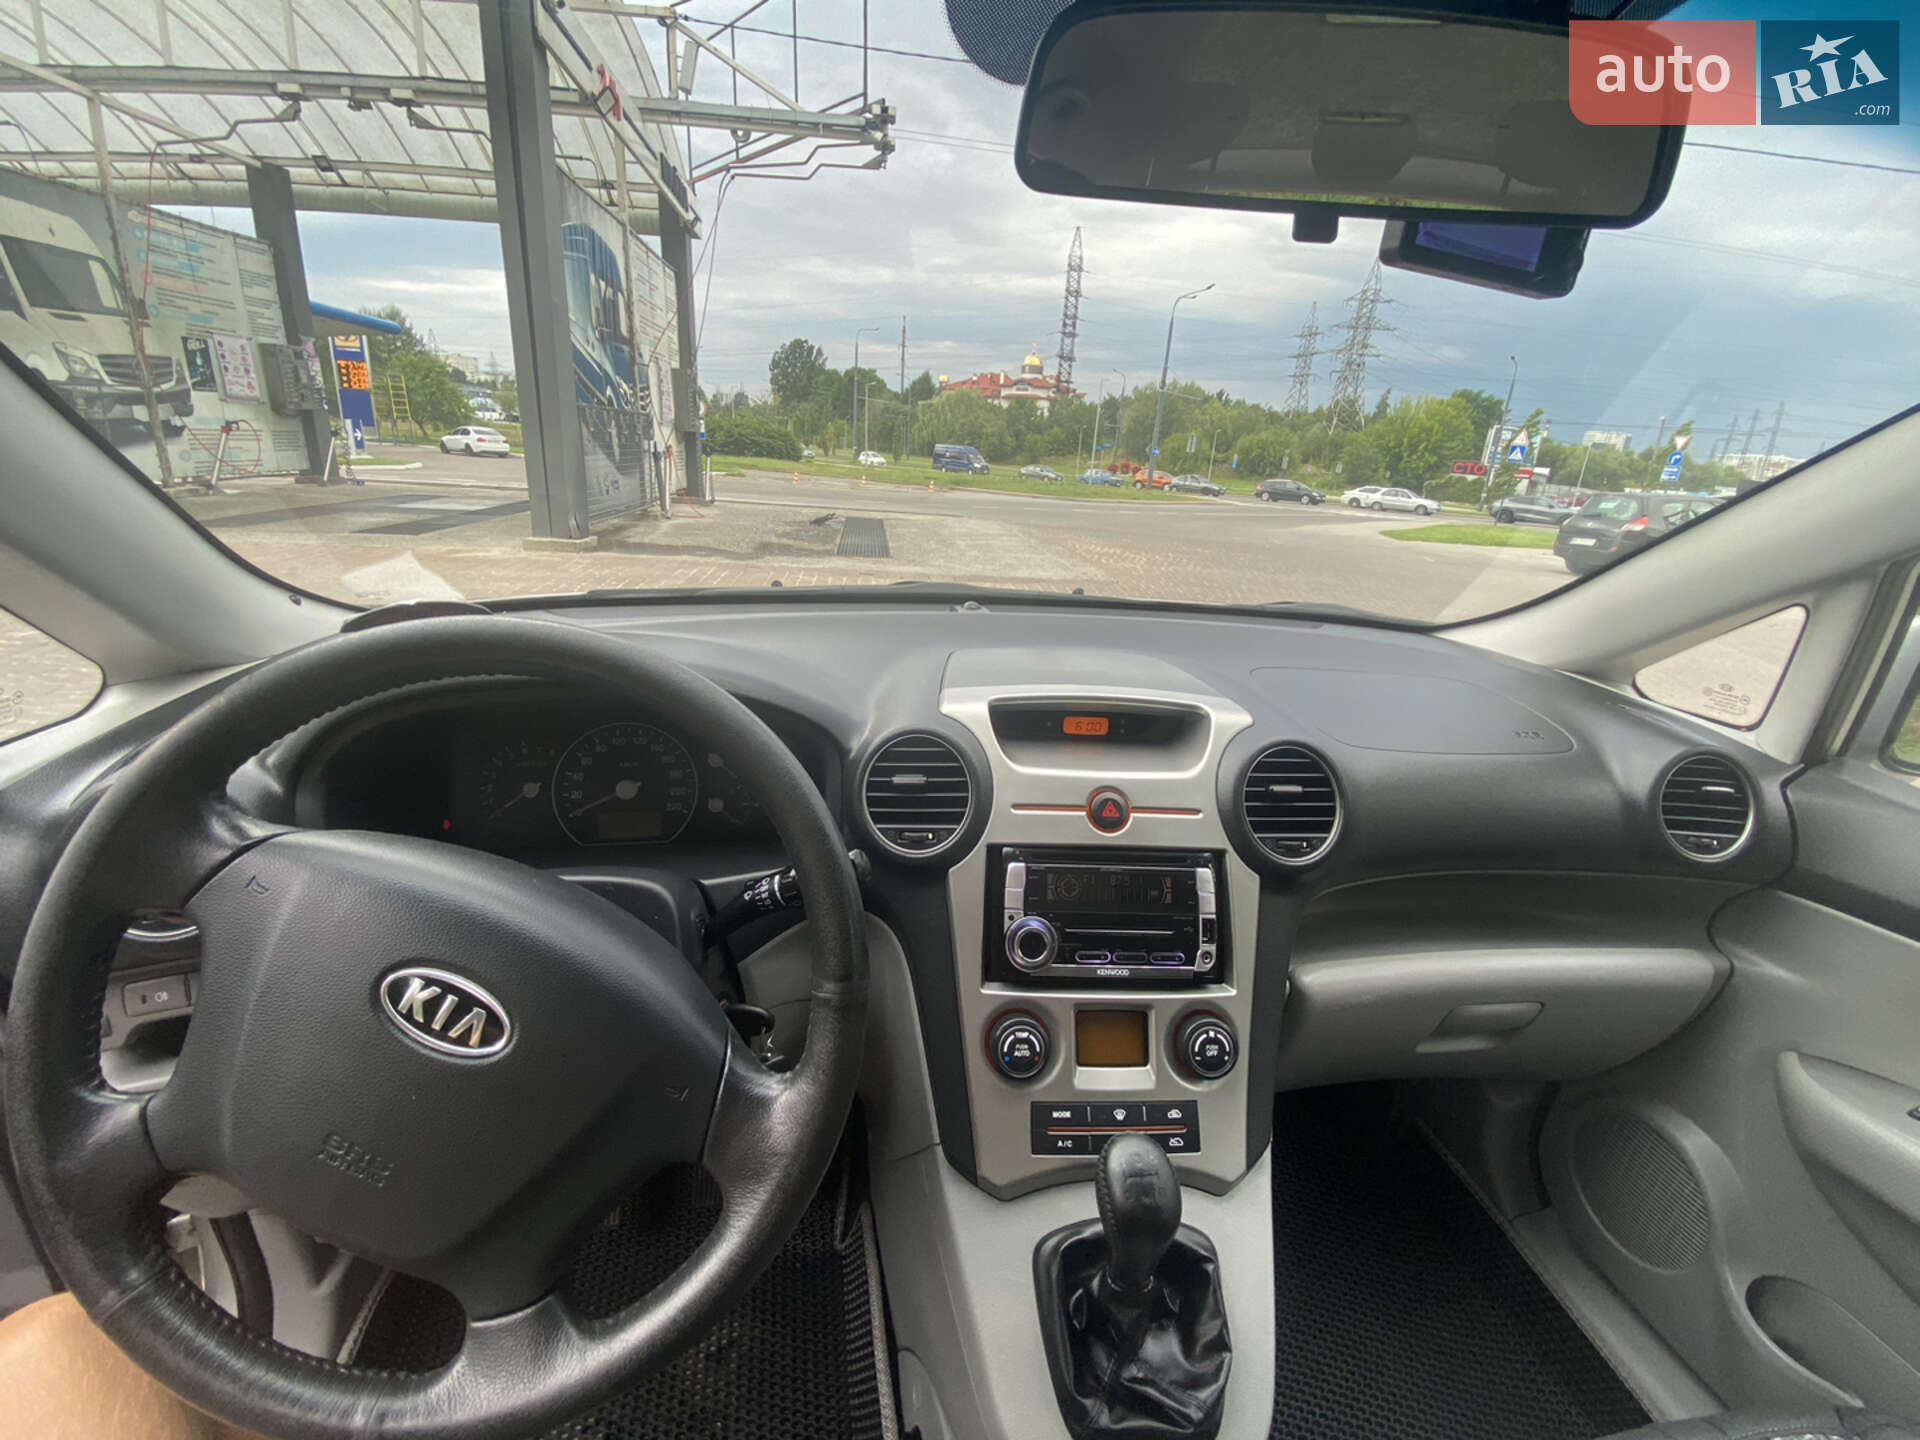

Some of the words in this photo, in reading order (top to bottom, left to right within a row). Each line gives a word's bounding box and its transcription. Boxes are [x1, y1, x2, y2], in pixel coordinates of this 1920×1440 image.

[1096, 968, 1130, 977] KENWOOD
[398, 976, 487, 1048] KIA
[1052, 1110, 1071, 1119] MODE
[1057, 1139, 1073, 1149] A/C
